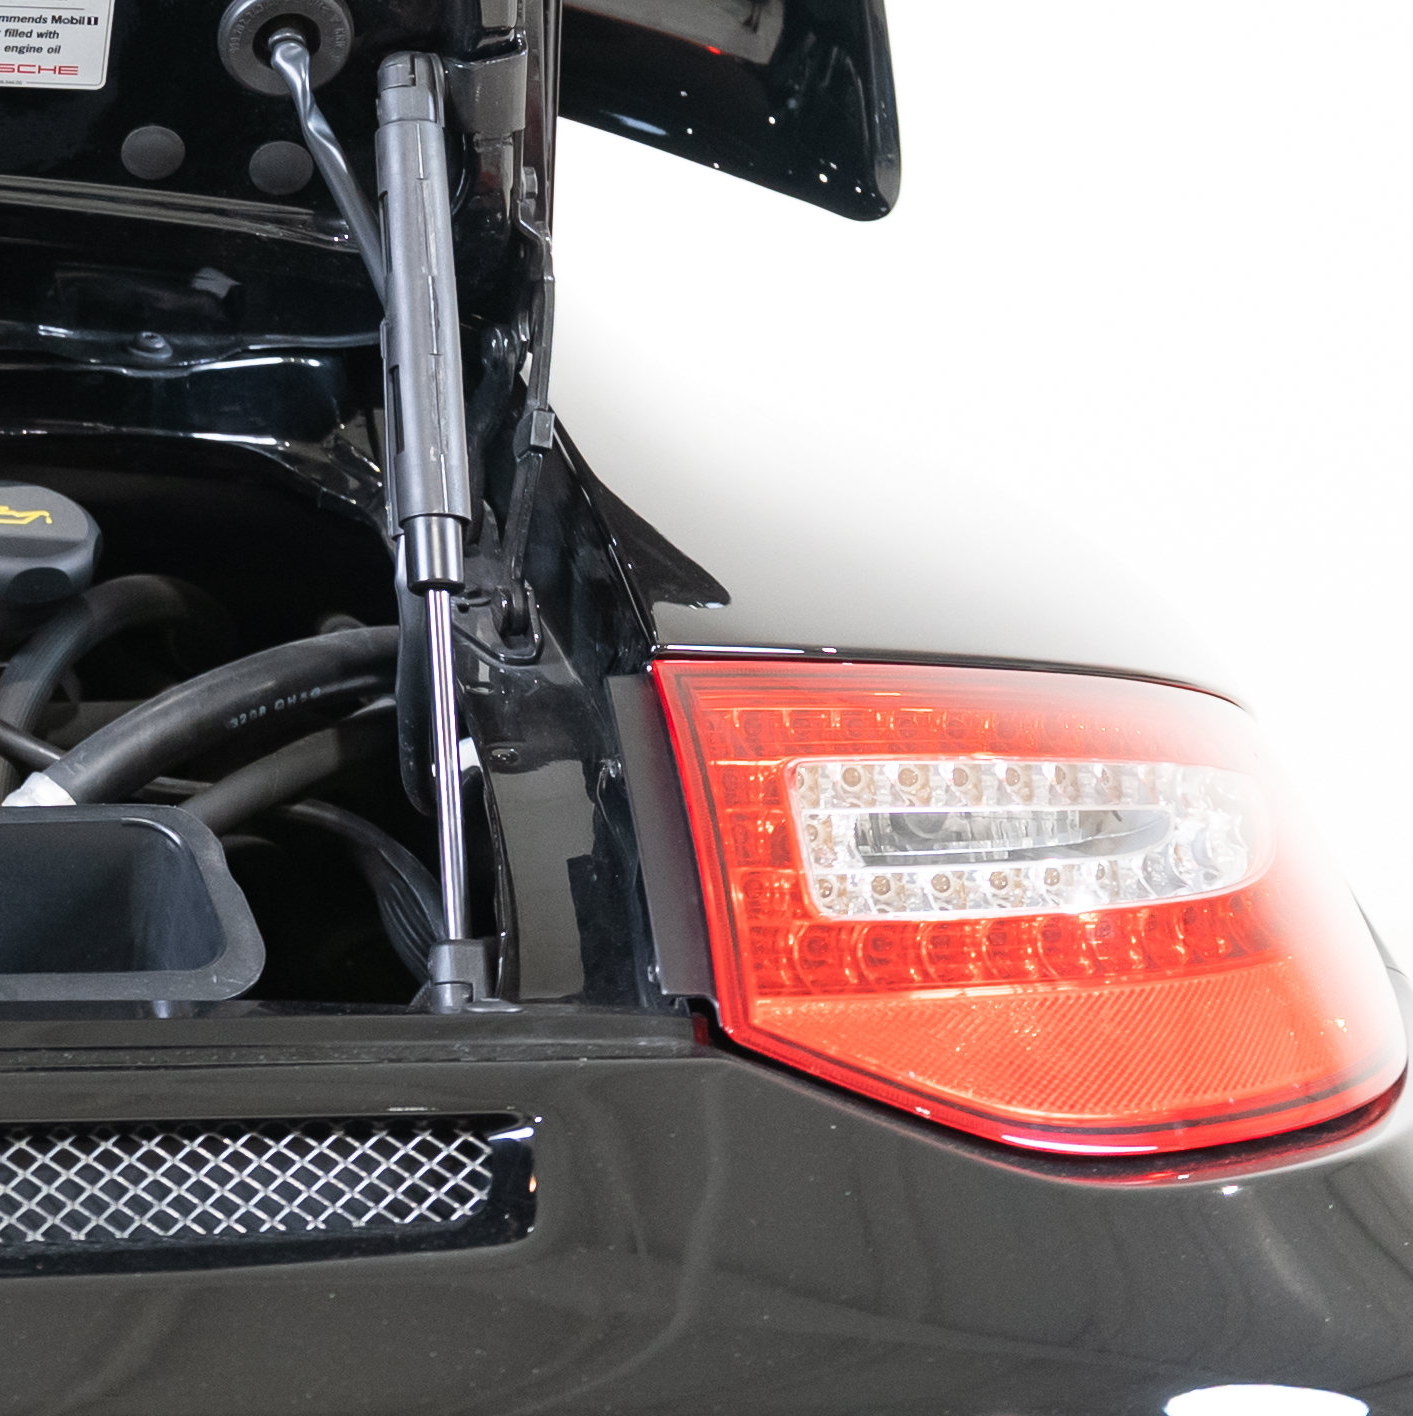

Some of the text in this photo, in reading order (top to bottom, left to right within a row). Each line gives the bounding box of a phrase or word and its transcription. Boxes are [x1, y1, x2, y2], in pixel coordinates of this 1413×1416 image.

[4, 29, 33, 39] filled
[36, 30, 60, 39] with
[4, 44, 43, 55] engine
[47, 44, 61, 54] oil
